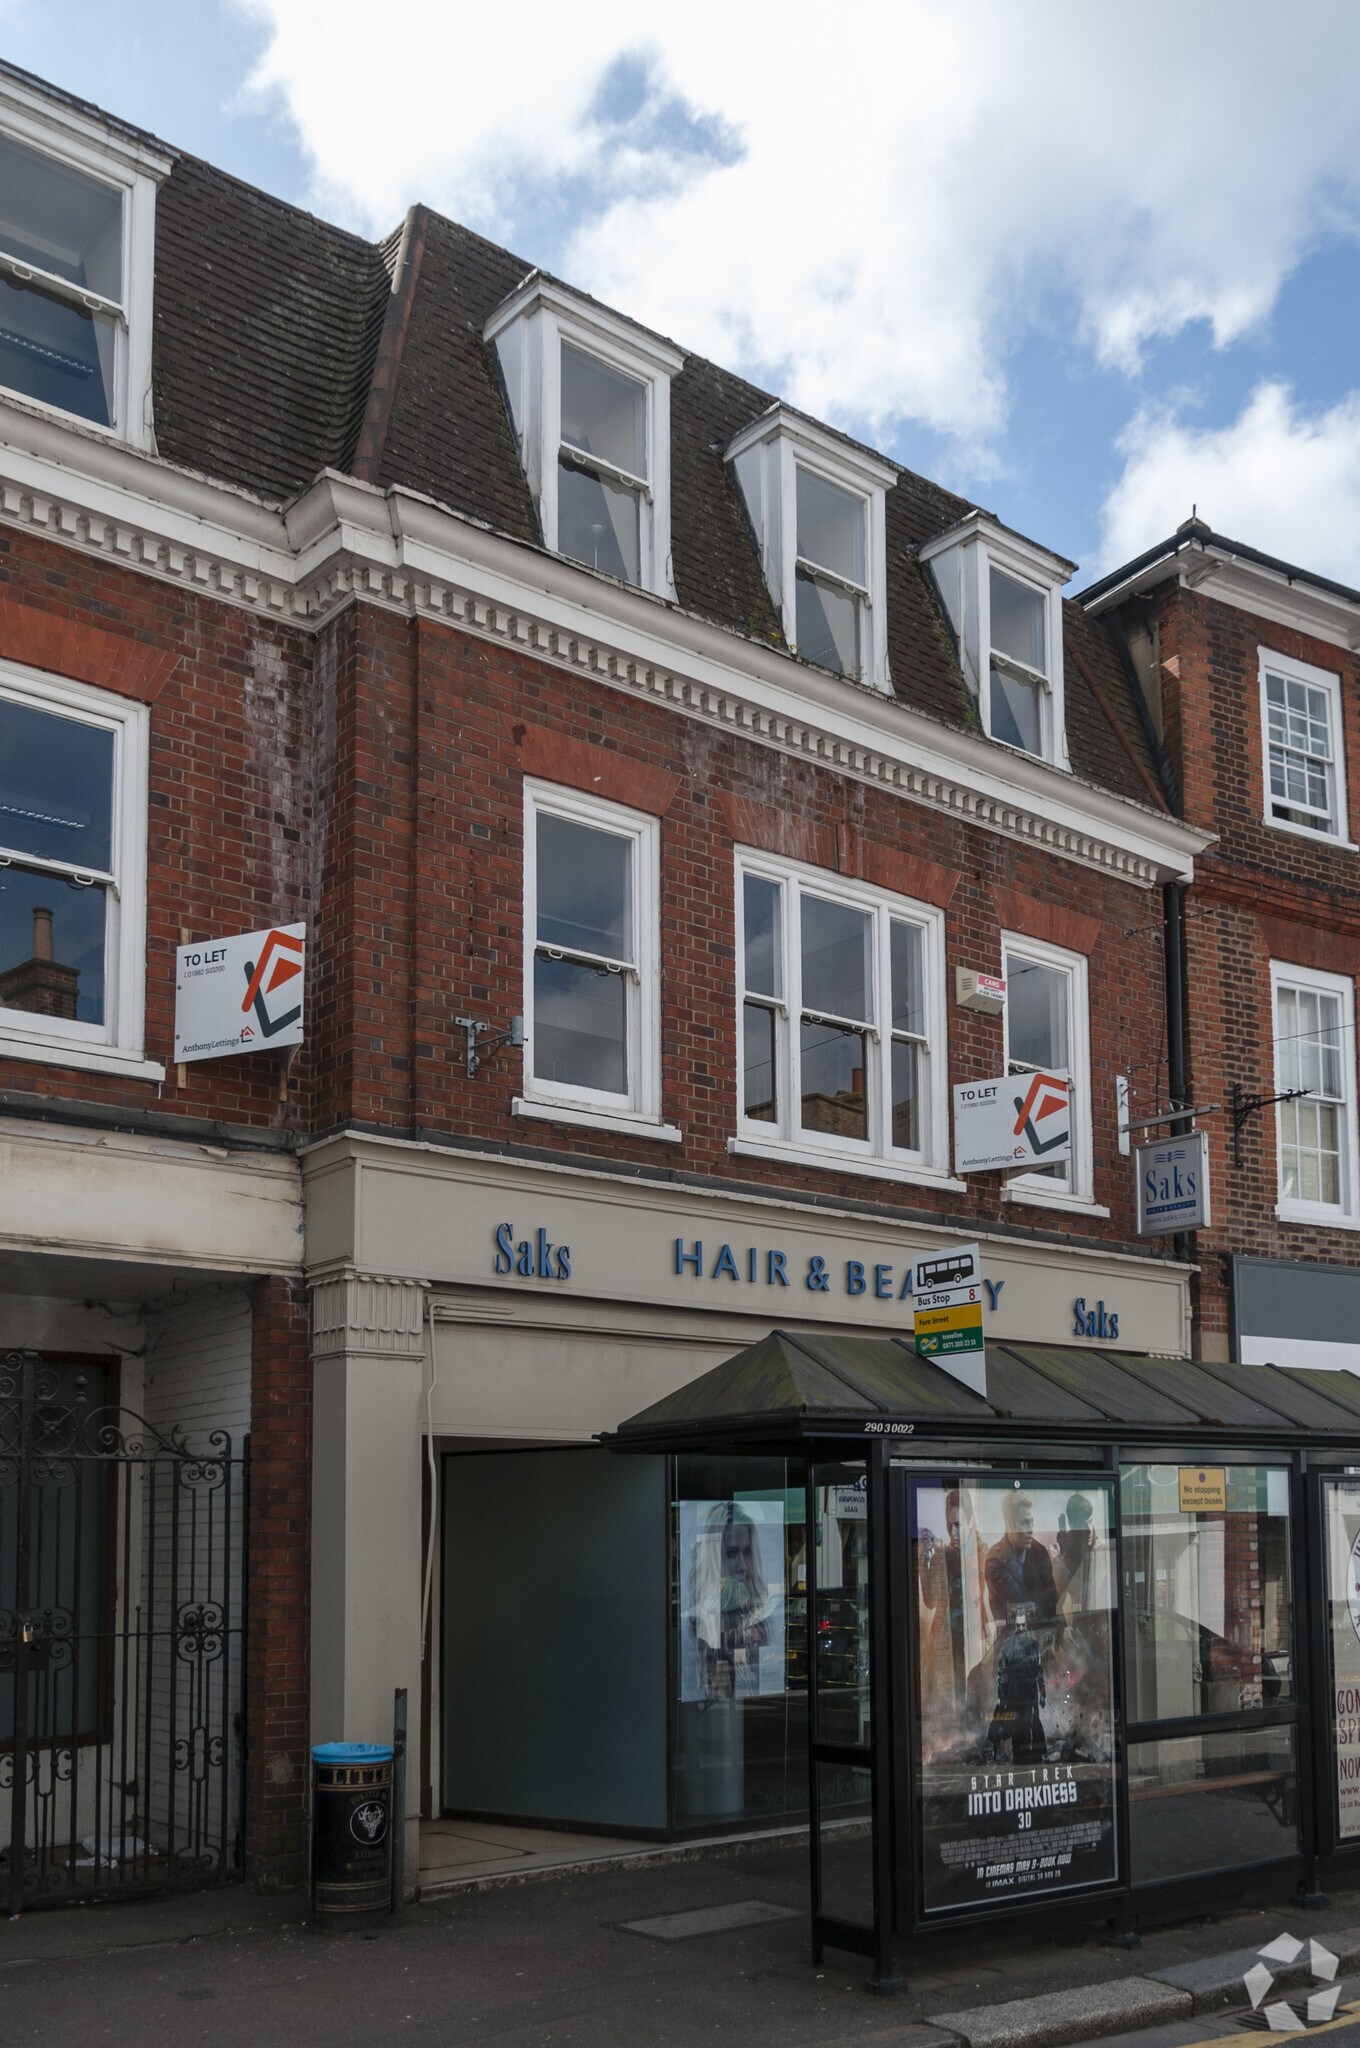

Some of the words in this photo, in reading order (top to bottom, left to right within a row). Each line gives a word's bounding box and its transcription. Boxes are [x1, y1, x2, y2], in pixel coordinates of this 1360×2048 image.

[184, 954, 200, 967] TO
[204, 949, 227, 963] LET
[961, 1090, 975, 1101] TO
[978, 1087, 998, 1098] LET
[1145, 1165, 1196, 1203] Saks
[495, 1222, 572, 1281] Saks
[675, 1238, 791, 1287] HAIR
[807, 1255, 830, 1292] &
[846, 1260, 1005, 1311] BEAY
[918, 1297, 931, 1306] Bus
[932, 1295, 950, 1304] Stop
[969, 1288, 975, 1301] 8
[932, 1316, 949, 1324] Street
[1073, 1297, 1120, 1340] Saks
[942, 1332, 963, 1340] traveline
[1184, 1486, 1193, 1494] No
[1194, 1486, 1221, 1495] stopping
[1182, 1498, 1203, 1506] except
[1205, 1497, 1223, 1505] buses
[971, 1772, 1014, 1791] STAR
[1032, 1766, 1073, 1783] TREK
[968, 1791, 1002, 1816] INTO
[1005, 1781, 1077, 1811] DARKNESS
[1018, 1811, 1032, 1829] 3D
[977, 1867, 984, 1879] IN
[986, 1862, 1014, 1877] CINEMAS
[1016, 1859, 1031, 1872] MAY
[1057, 1853, 1072, 1866] NOW
[992, 1877, 1015, 1887] IMAX
[1018, 1872, 1036, 1883] DIGITAL
